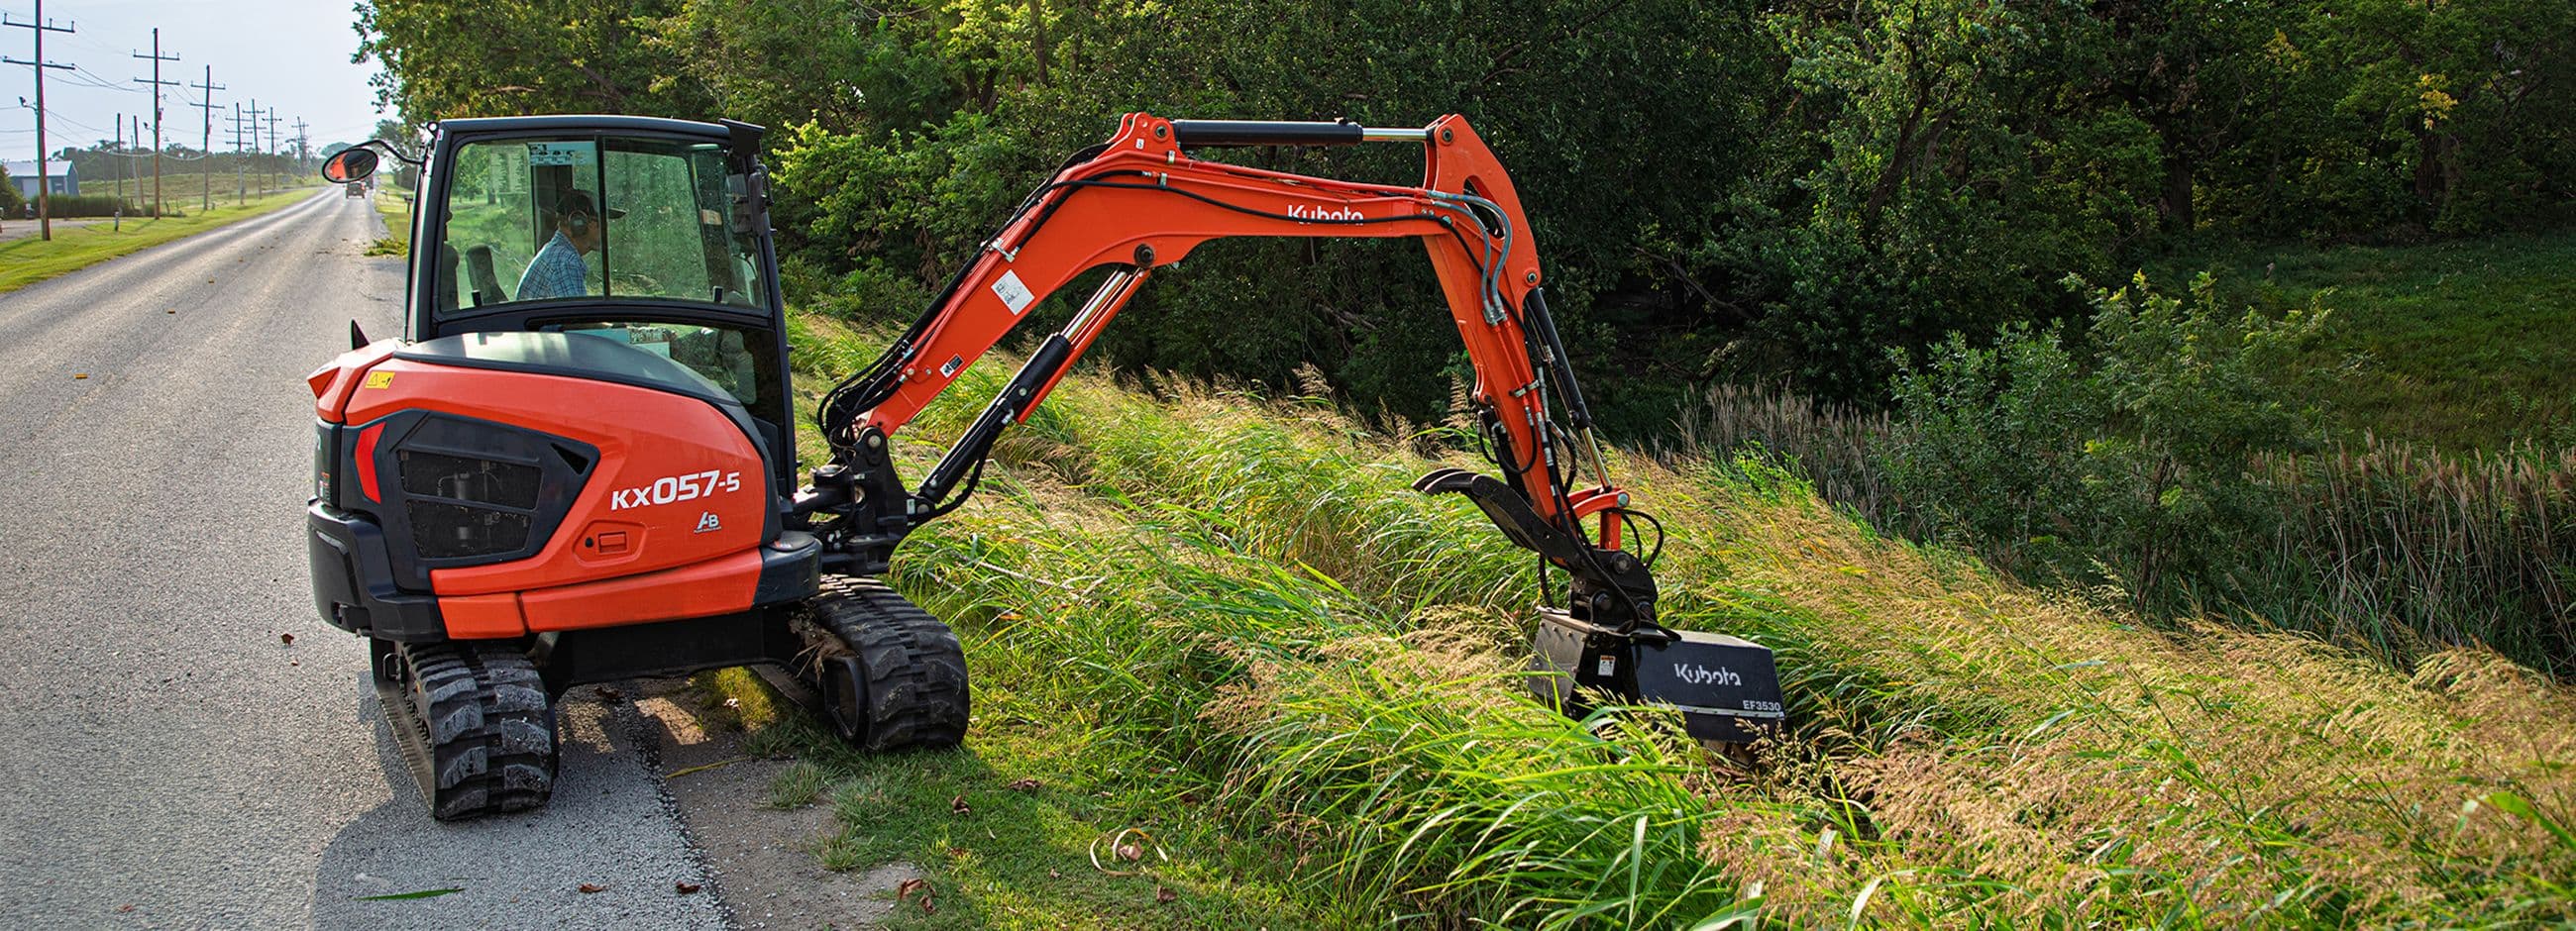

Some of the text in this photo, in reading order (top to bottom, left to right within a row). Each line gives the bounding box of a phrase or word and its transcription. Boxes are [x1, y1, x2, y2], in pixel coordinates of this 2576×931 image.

[610, 469, 740, 510] KX057-5
[1674, 663, 1742, 686] Kubota
[1743, 699, 1780, 711] EF3530
